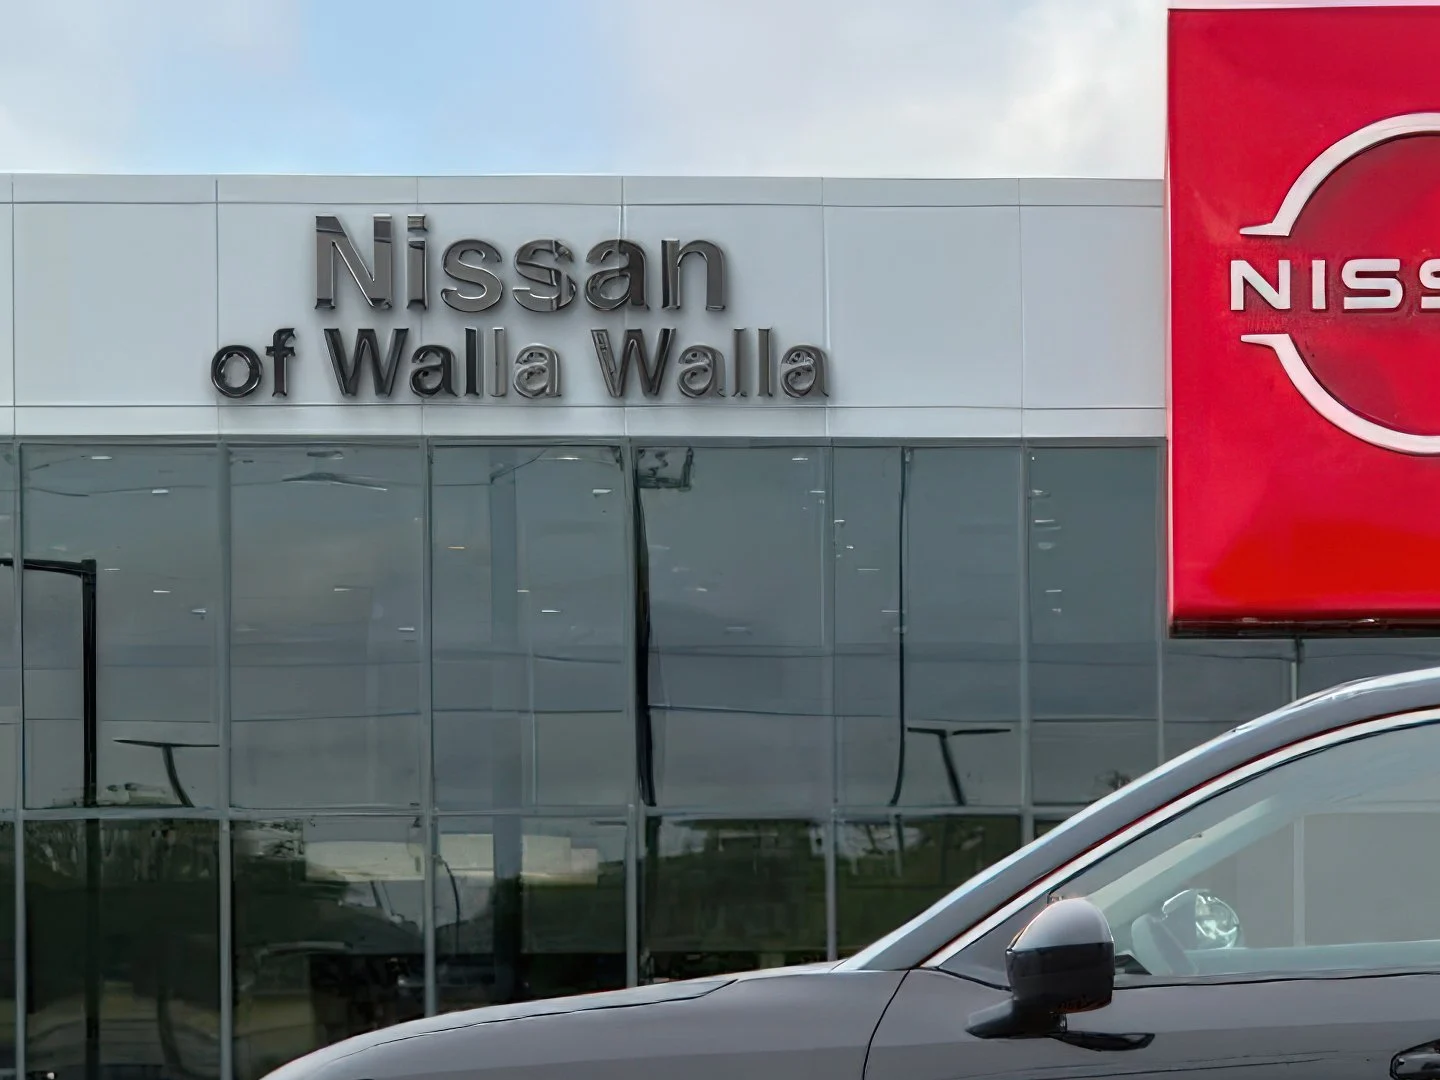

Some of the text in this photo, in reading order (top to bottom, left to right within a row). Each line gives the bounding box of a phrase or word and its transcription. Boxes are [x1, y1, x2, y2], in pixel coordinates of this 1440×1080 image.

[314, 213, 728, 312] Nissan
[209, 327, 831, 399] of Walla Walla
